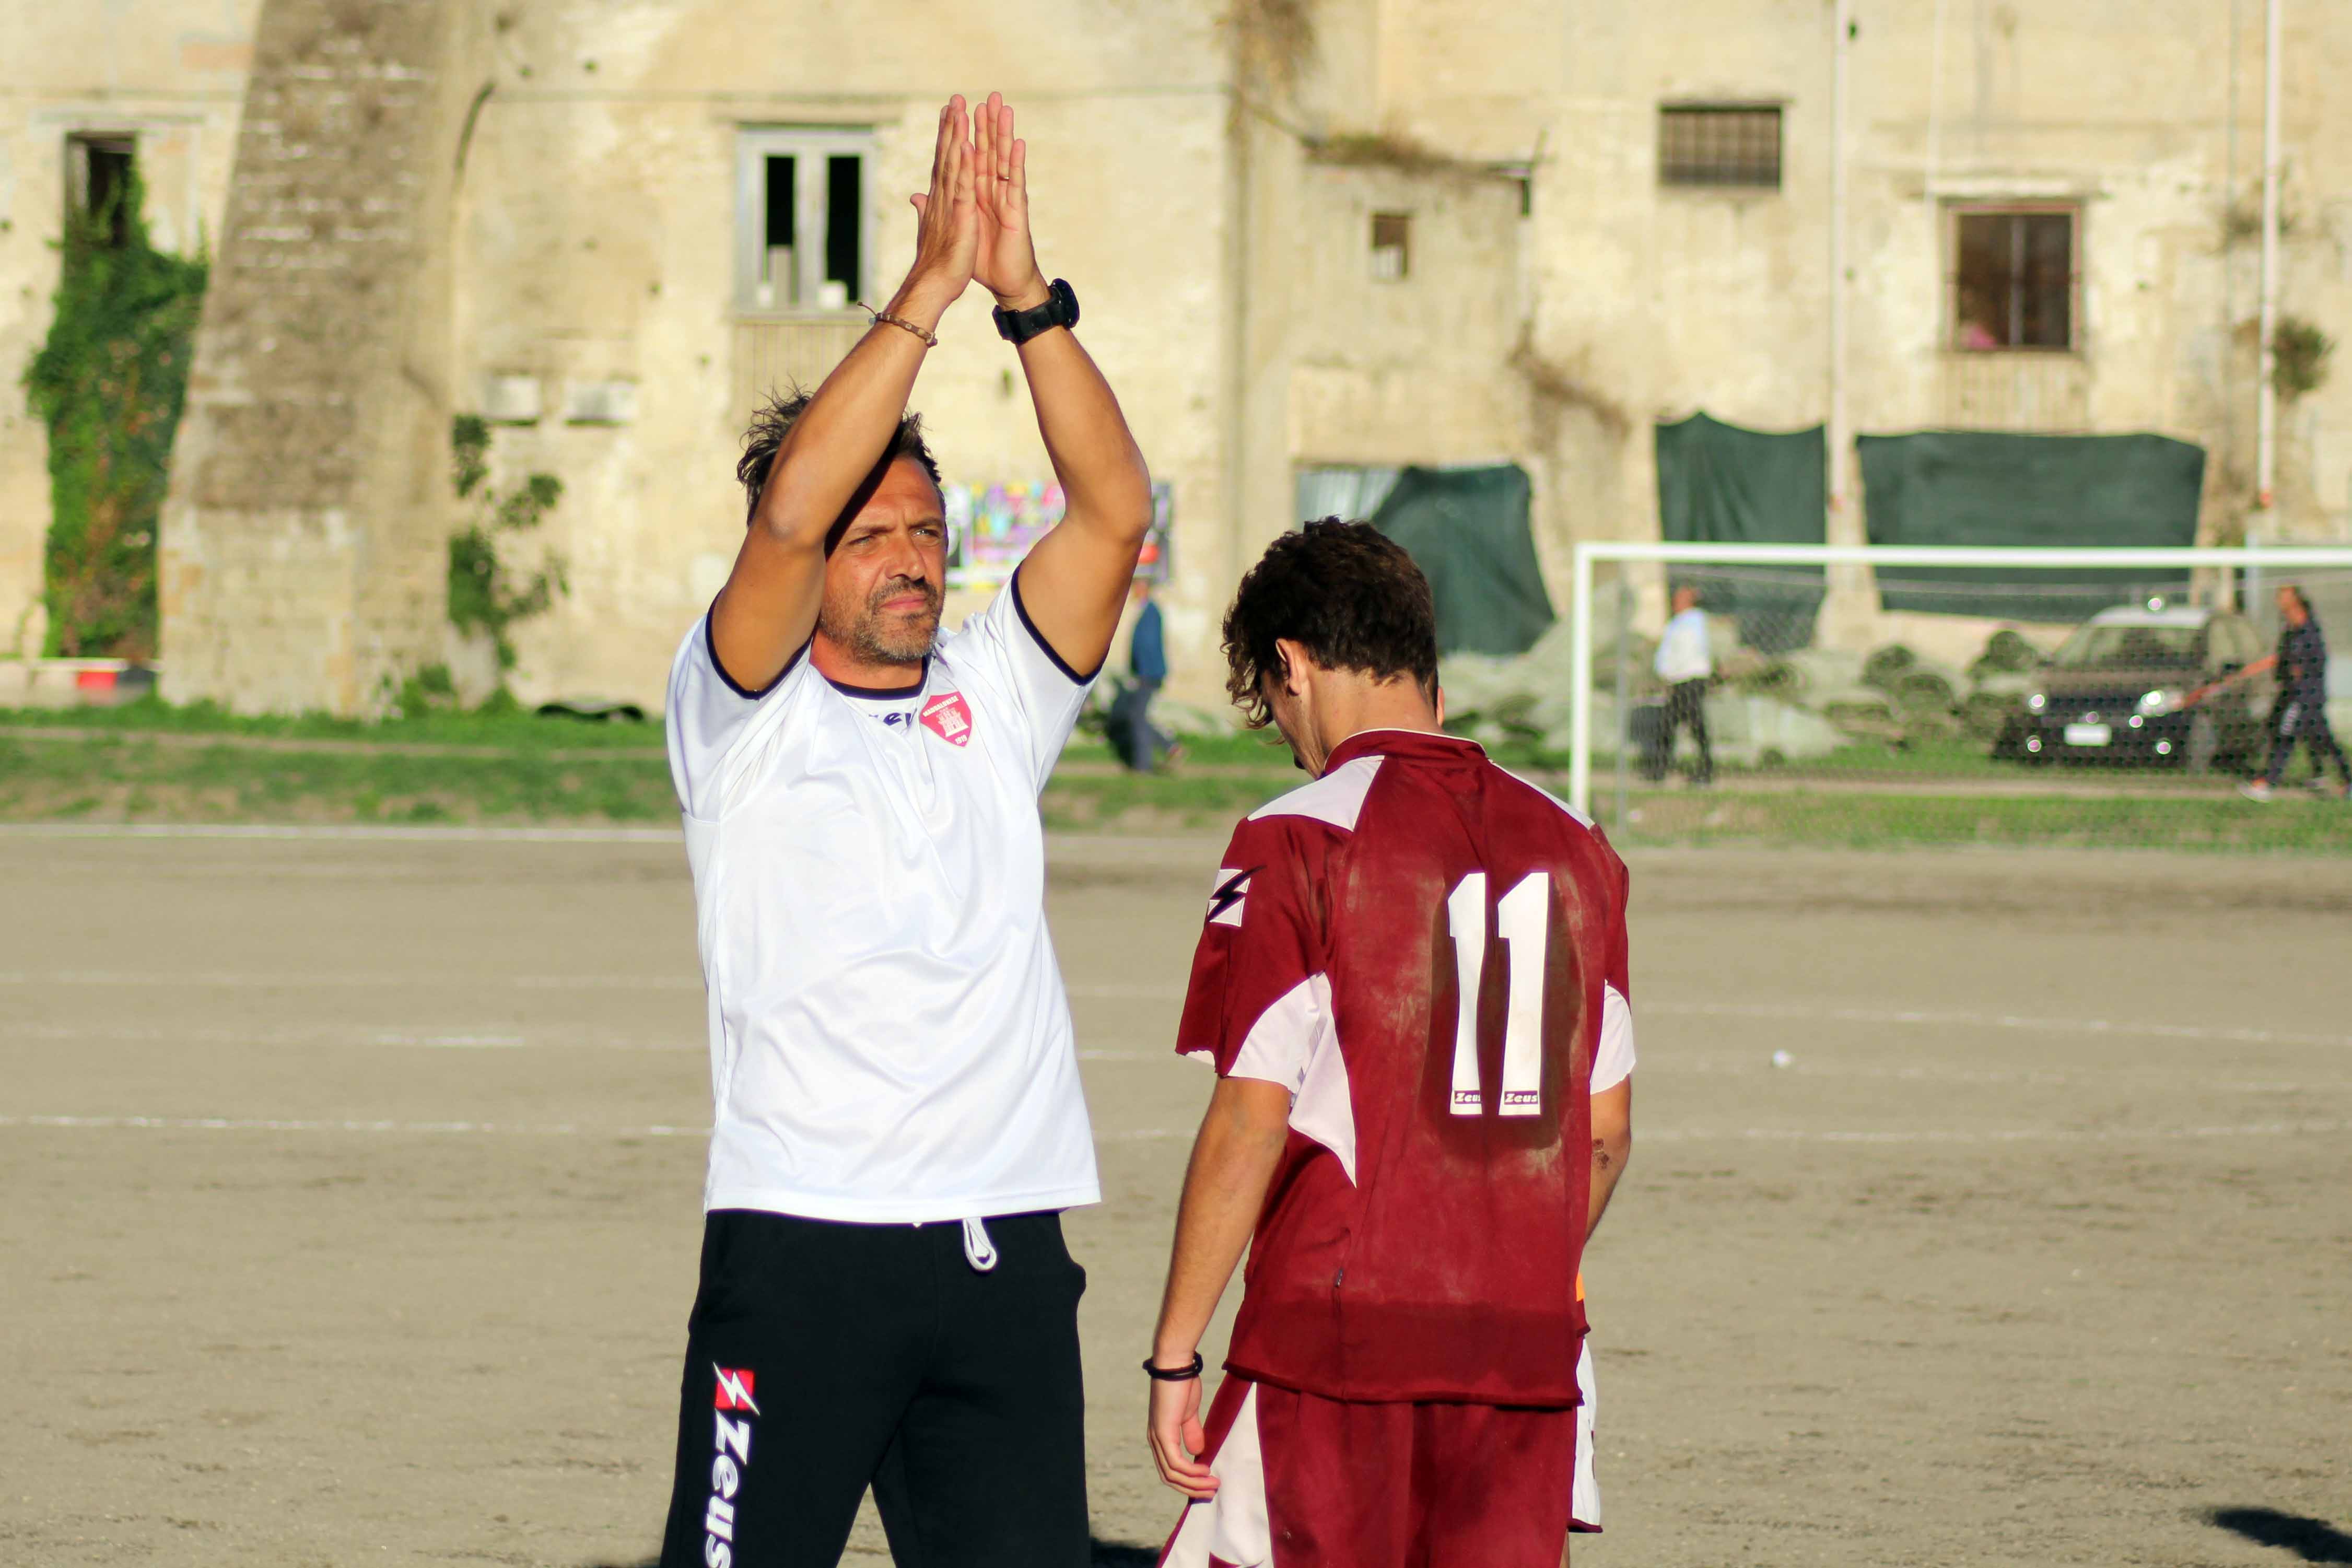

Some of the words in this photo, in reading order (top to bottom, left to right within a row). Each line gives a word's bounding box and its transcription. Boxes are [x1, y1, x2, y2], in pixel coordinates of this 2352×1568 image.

[955, 734, 967, 744] 1919
[1448, 872, 1549, 1115] 11
[1504, 1093, 1537, 1102] Zeus
[706, 1409, 750, 1568] Zeus
